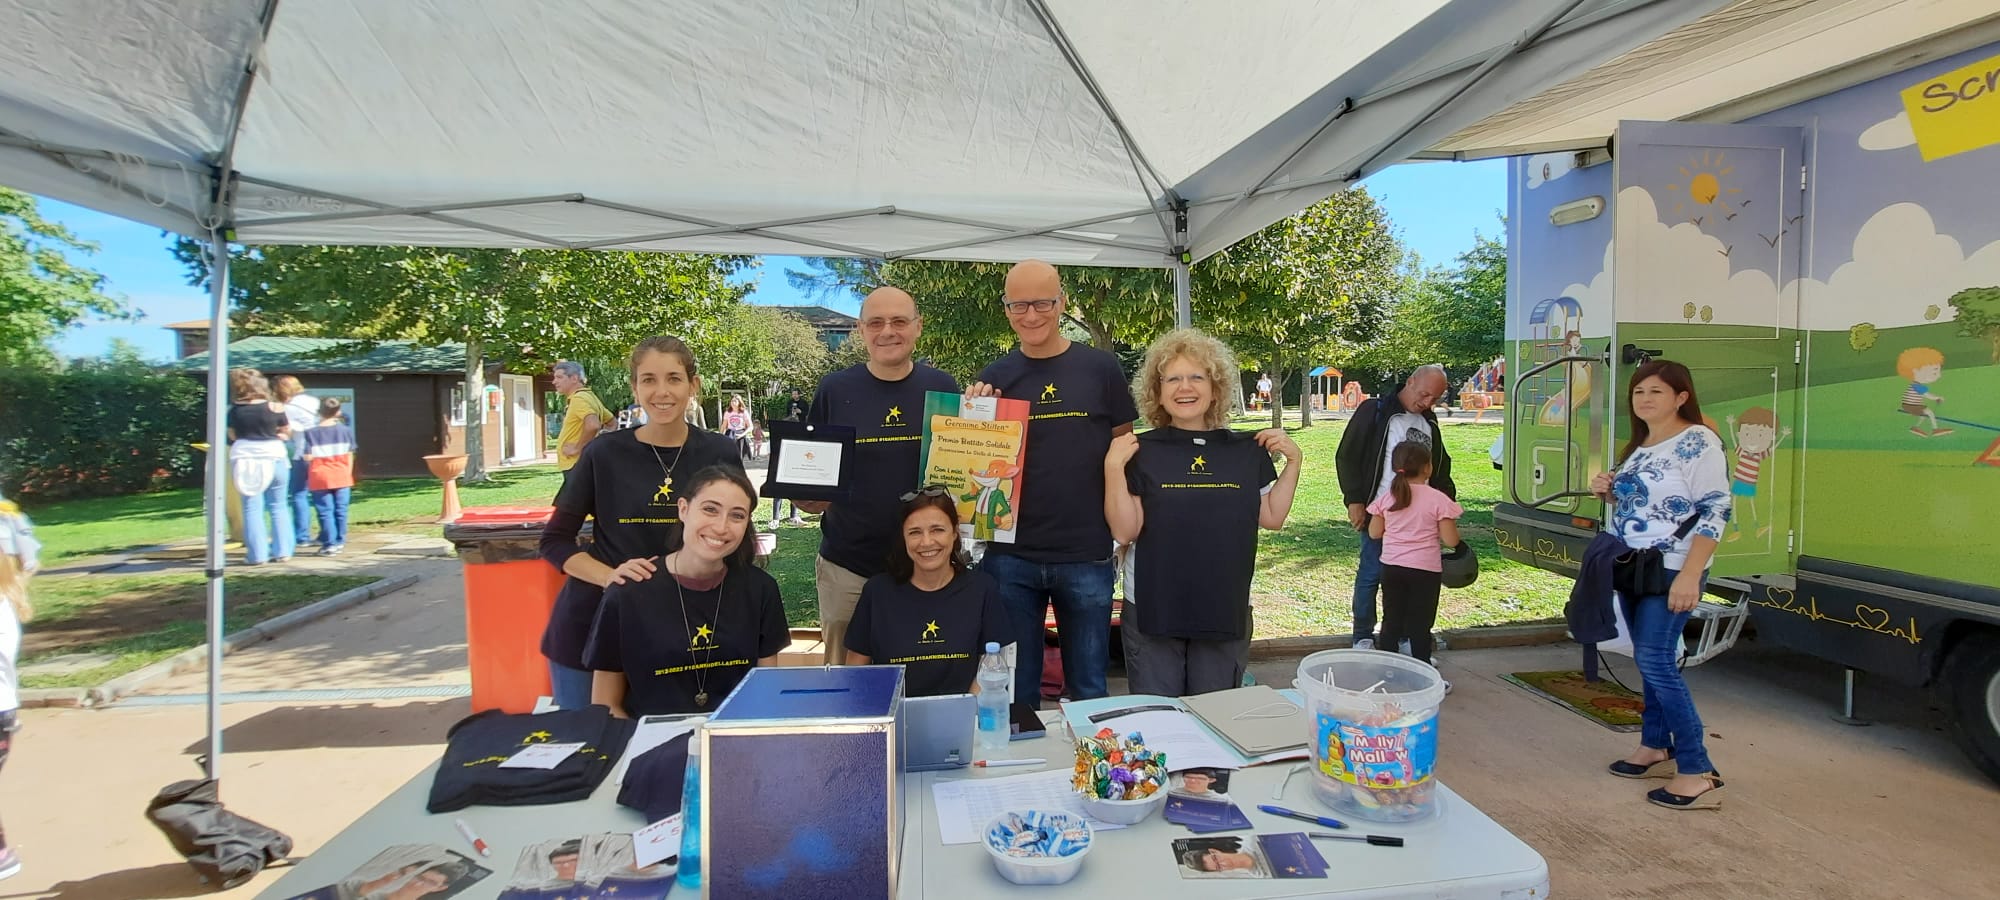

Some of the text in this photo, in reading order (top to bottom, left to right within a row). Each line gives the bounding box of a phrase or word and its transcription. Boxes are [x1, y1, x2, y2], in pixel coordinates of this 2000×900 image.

[944, 418, 979, 429] Geronimo
[937, 434, 1012, 450] Premio Battito Solidale
[934, 465, 946, 473] Con
[1354, 733, 1396, 750] Molly
[1348, 747, 1409, 764] Mallow
